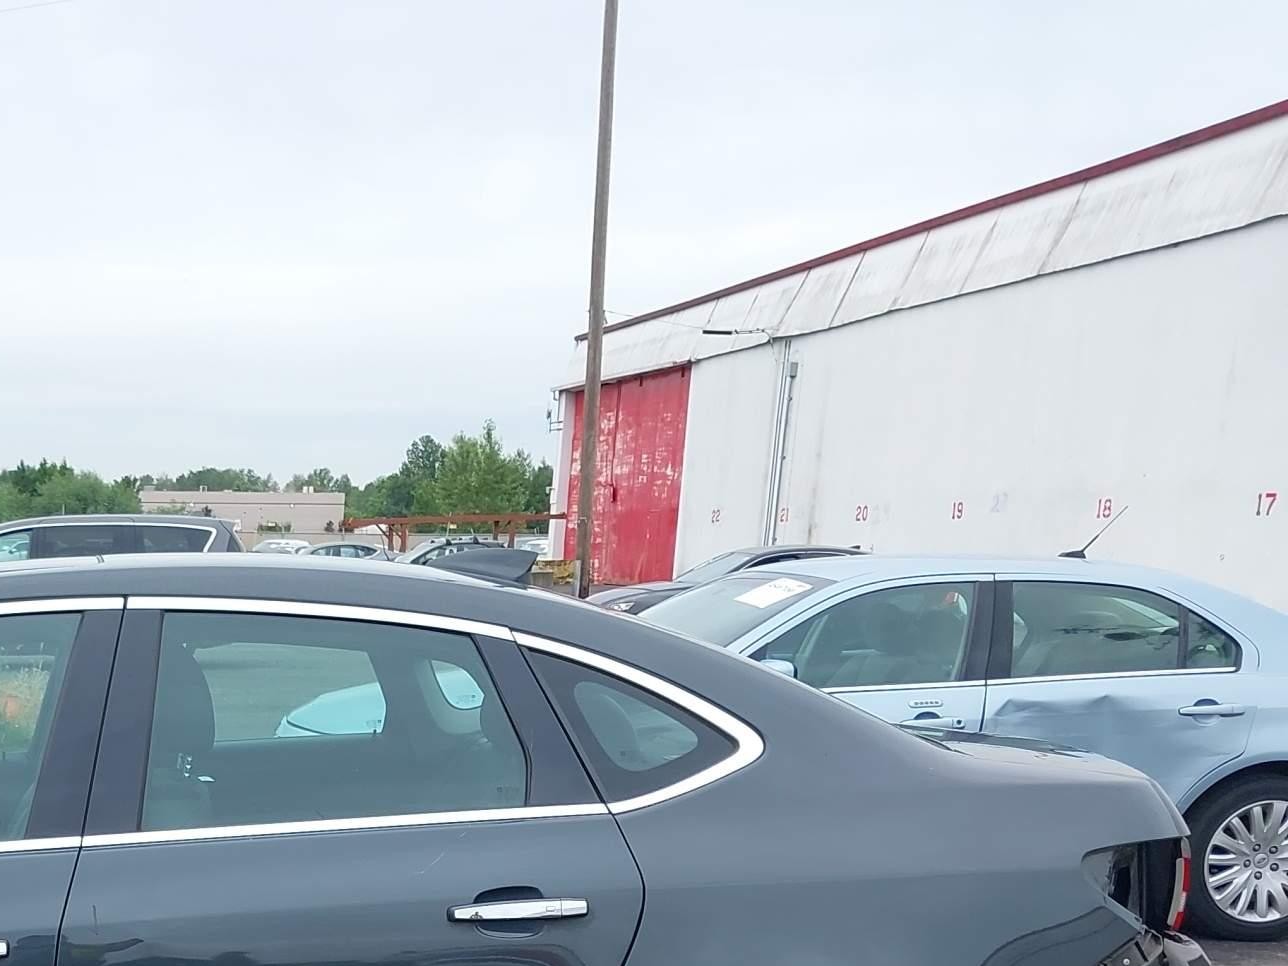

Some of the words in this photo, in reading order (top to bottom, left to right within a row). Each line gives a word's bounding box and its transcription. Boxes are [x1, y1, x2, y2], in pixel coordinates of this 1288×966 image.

[951, 502, 964, 520] 19
[1096, 499, 1113, 519] 18
[1256, 493, 1278, 516] 17
[711, 509, 721, 523] 22
[779, 507, 790, 522] 21
[855, 505, 869, 522] 20
